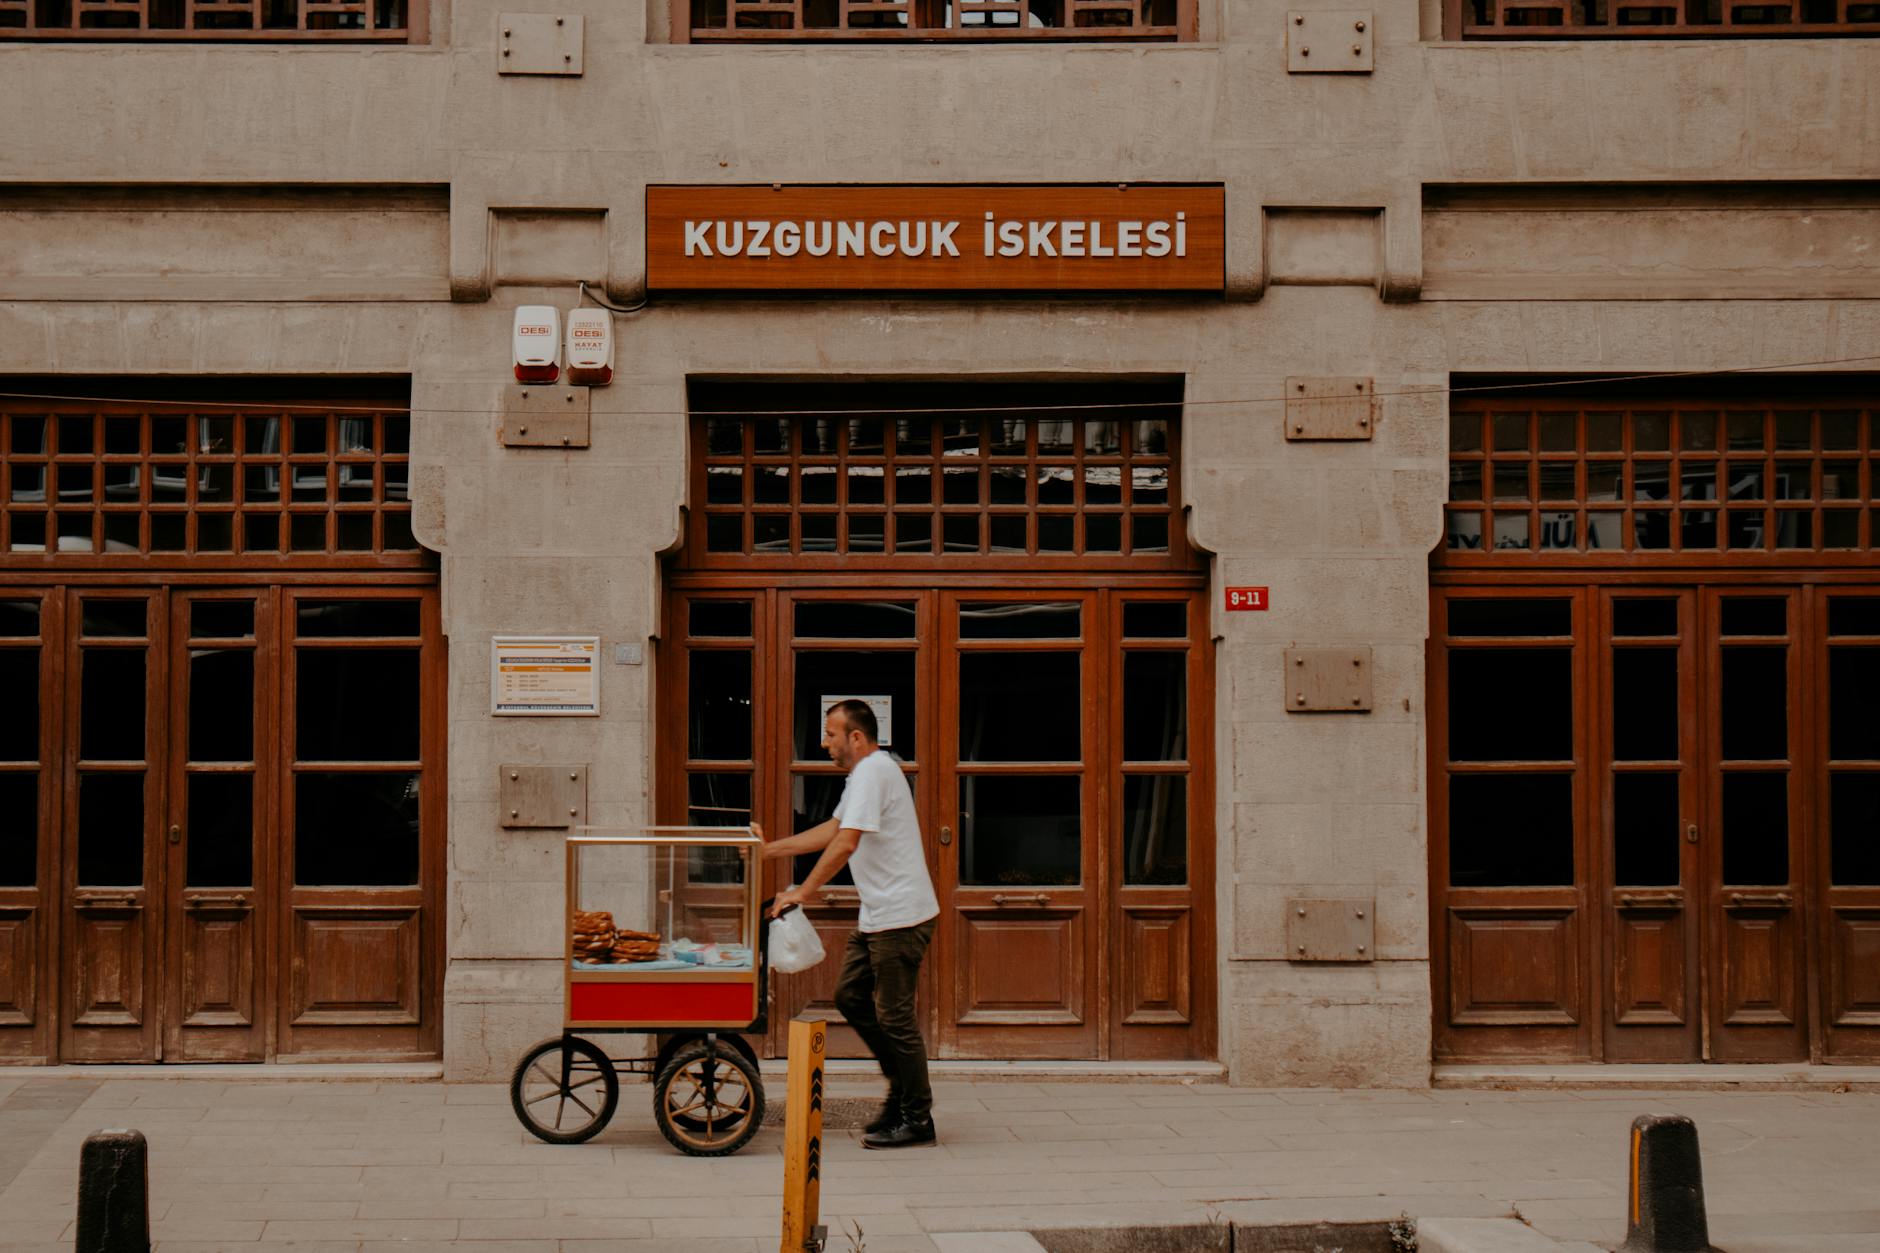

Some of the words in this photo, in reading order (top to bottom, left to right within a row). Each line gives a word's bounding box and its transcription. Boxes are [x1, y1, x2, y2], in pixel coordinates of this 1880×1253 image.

[685, 220, 961, 257] KUZGUNCUK
[984, 211, 1186, 257] İSKELESİ
[1231, 592, 1260, 605] 9-11
